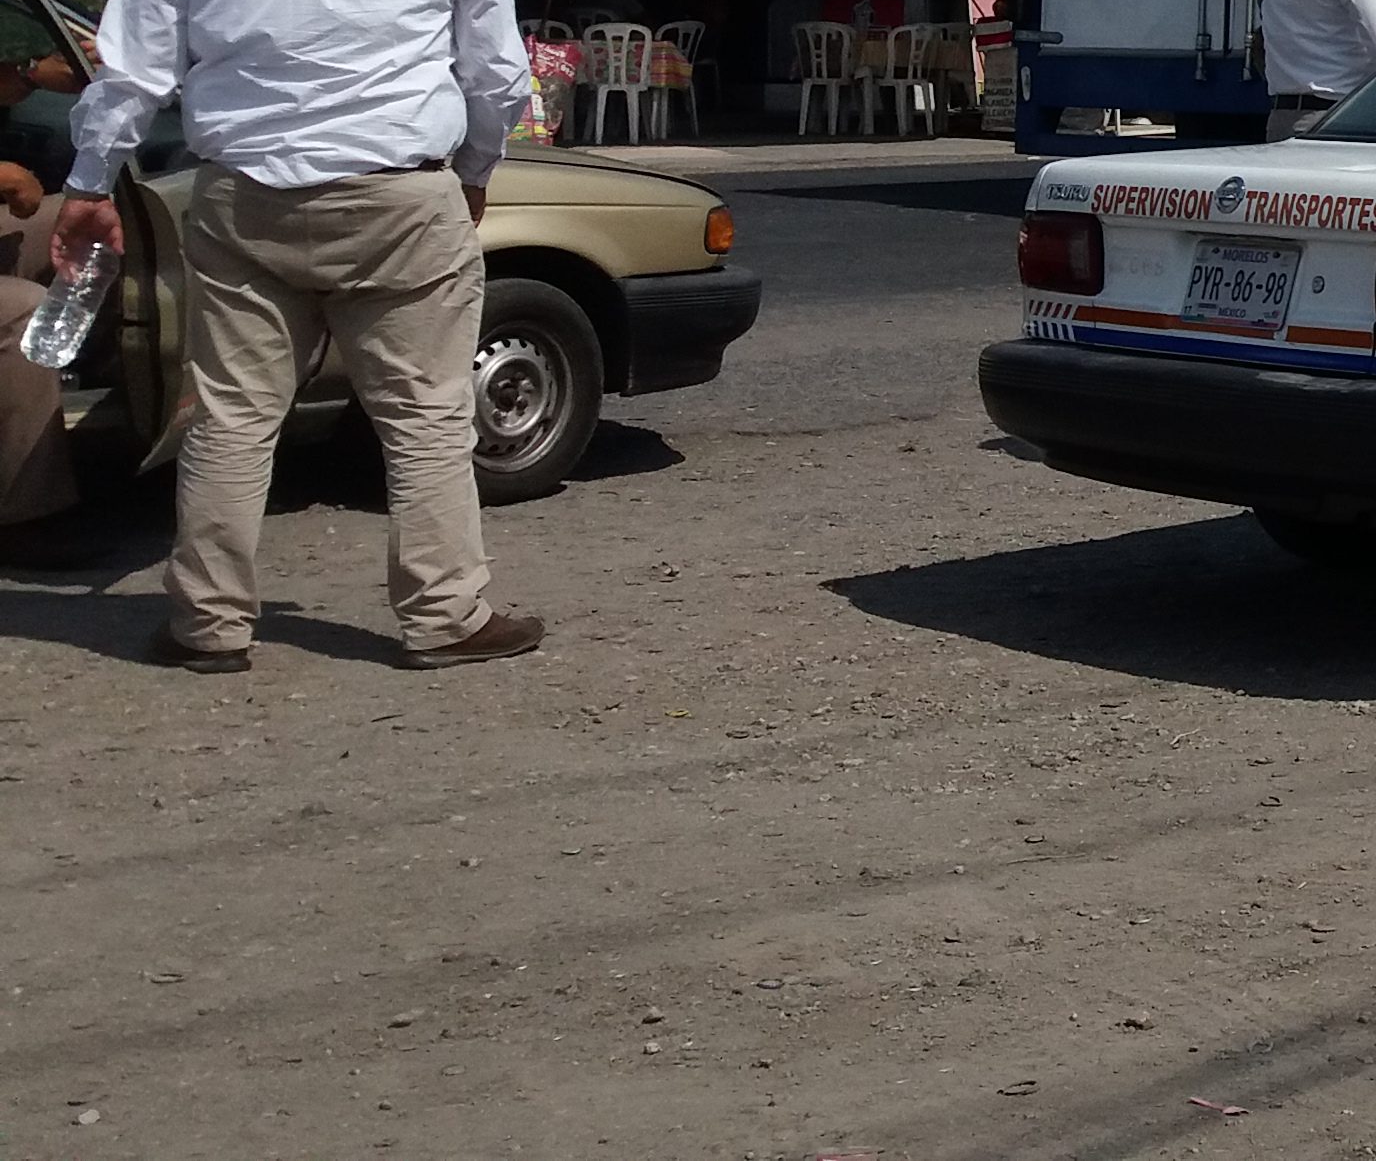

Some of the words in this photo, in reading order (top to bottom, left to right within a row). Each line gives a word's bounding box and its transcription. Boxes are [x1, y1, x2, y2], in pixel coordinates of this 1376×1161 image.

[1091, 184, 1214, 220] SUPERVISION
[1222, 249, 1270, 263] MORELOS
[1187, 265, 1287, 305] PYR-86-98
